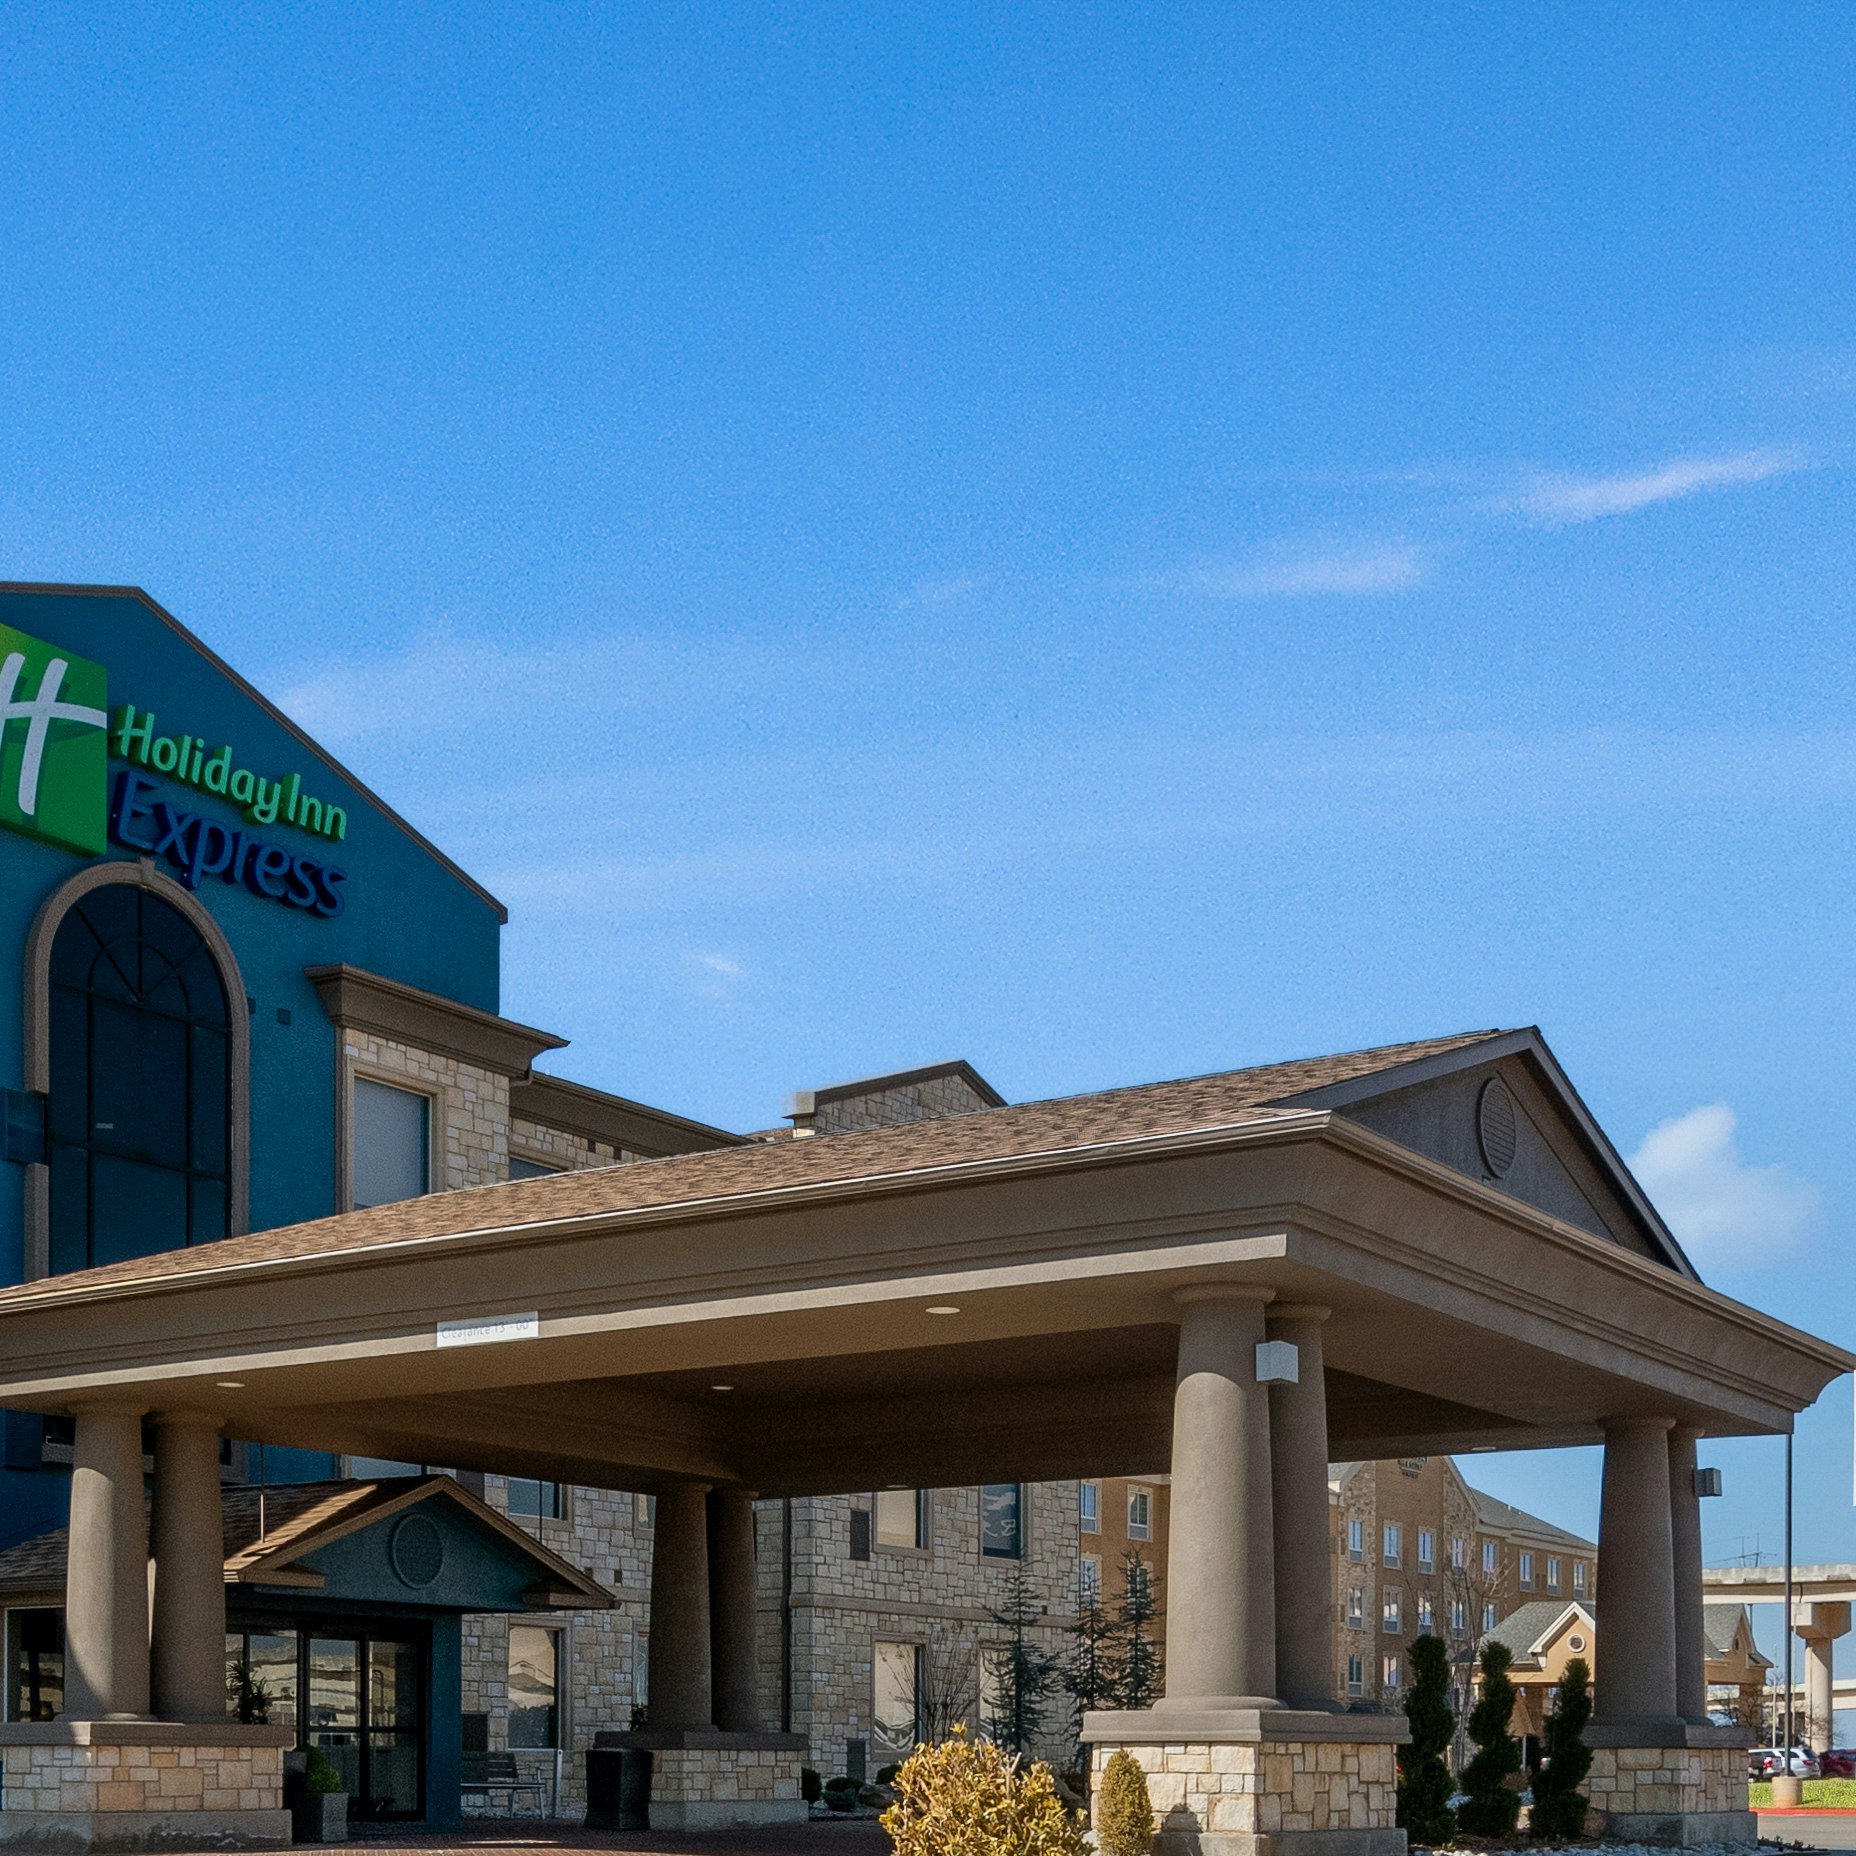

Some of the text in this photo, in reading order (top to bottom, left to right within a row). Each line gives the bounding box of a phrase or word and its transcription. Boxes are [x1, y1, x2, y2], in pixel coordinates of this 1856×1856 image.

[114, 703, 348, 841] Holiday Inn
[111, 770, 348, 918] Express
